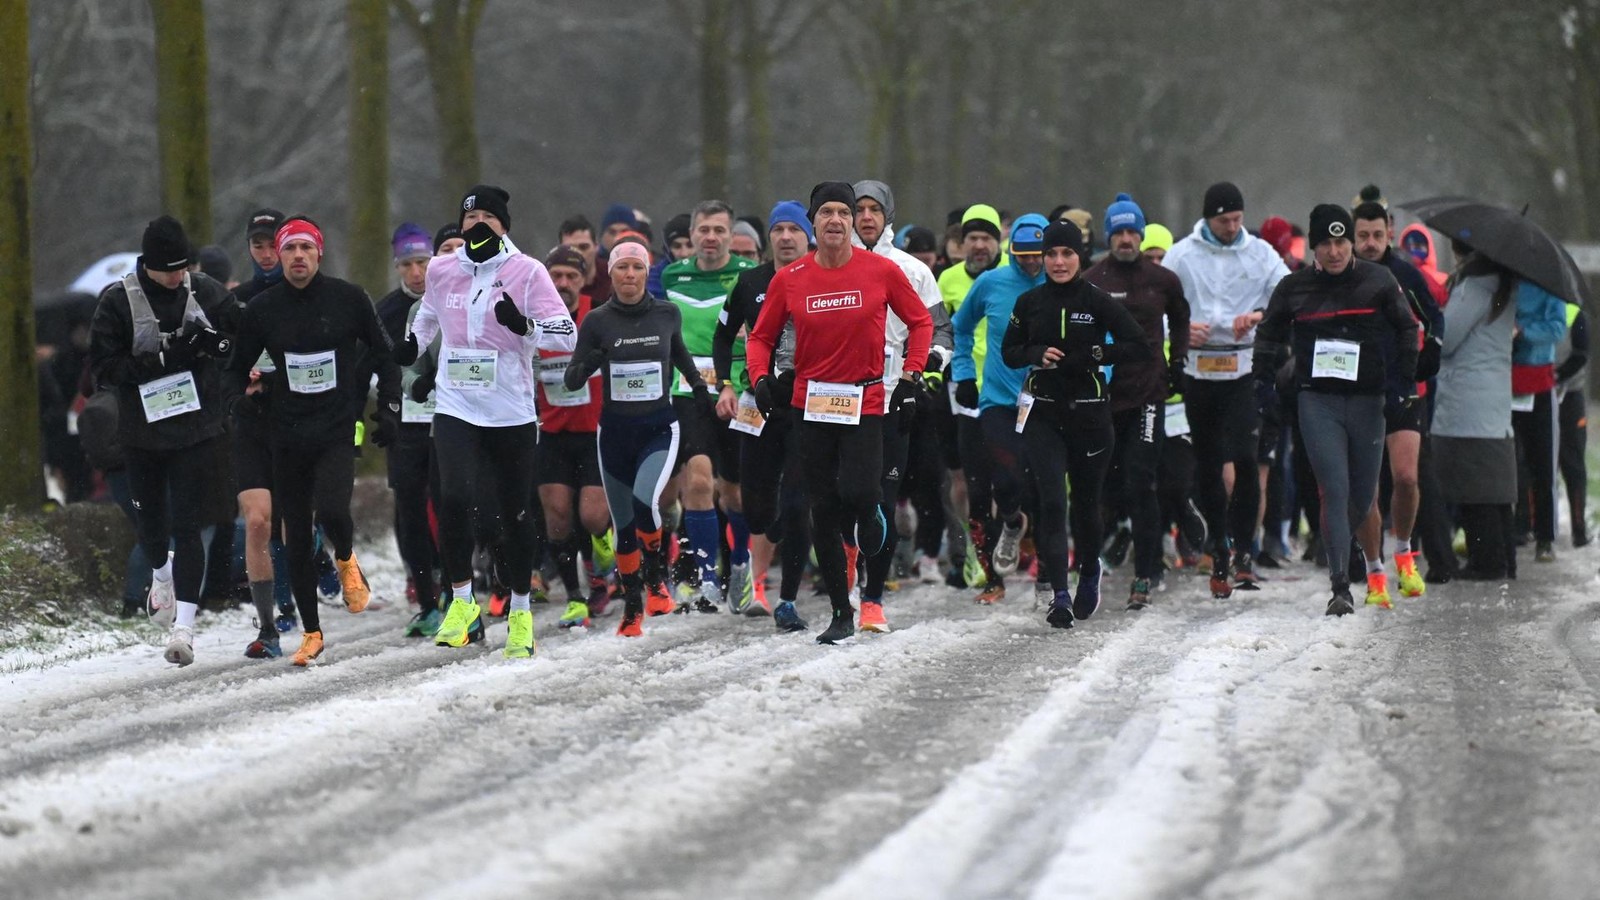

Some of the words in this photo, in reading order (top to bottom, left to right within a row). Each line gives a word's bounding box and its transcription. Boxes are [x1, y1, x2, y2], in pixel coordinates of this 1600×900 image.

[812, 296, 856, 308] cleverfit
[623, 336, 660, 345] FRONTRUNNER
[308, 368, 324, 378] 210
[469, 365, 480, 374] 42
[627, 379, 644, 388] 682
[166, 389, 183, 401] 372
[830, 397, 851, 407] 1213
